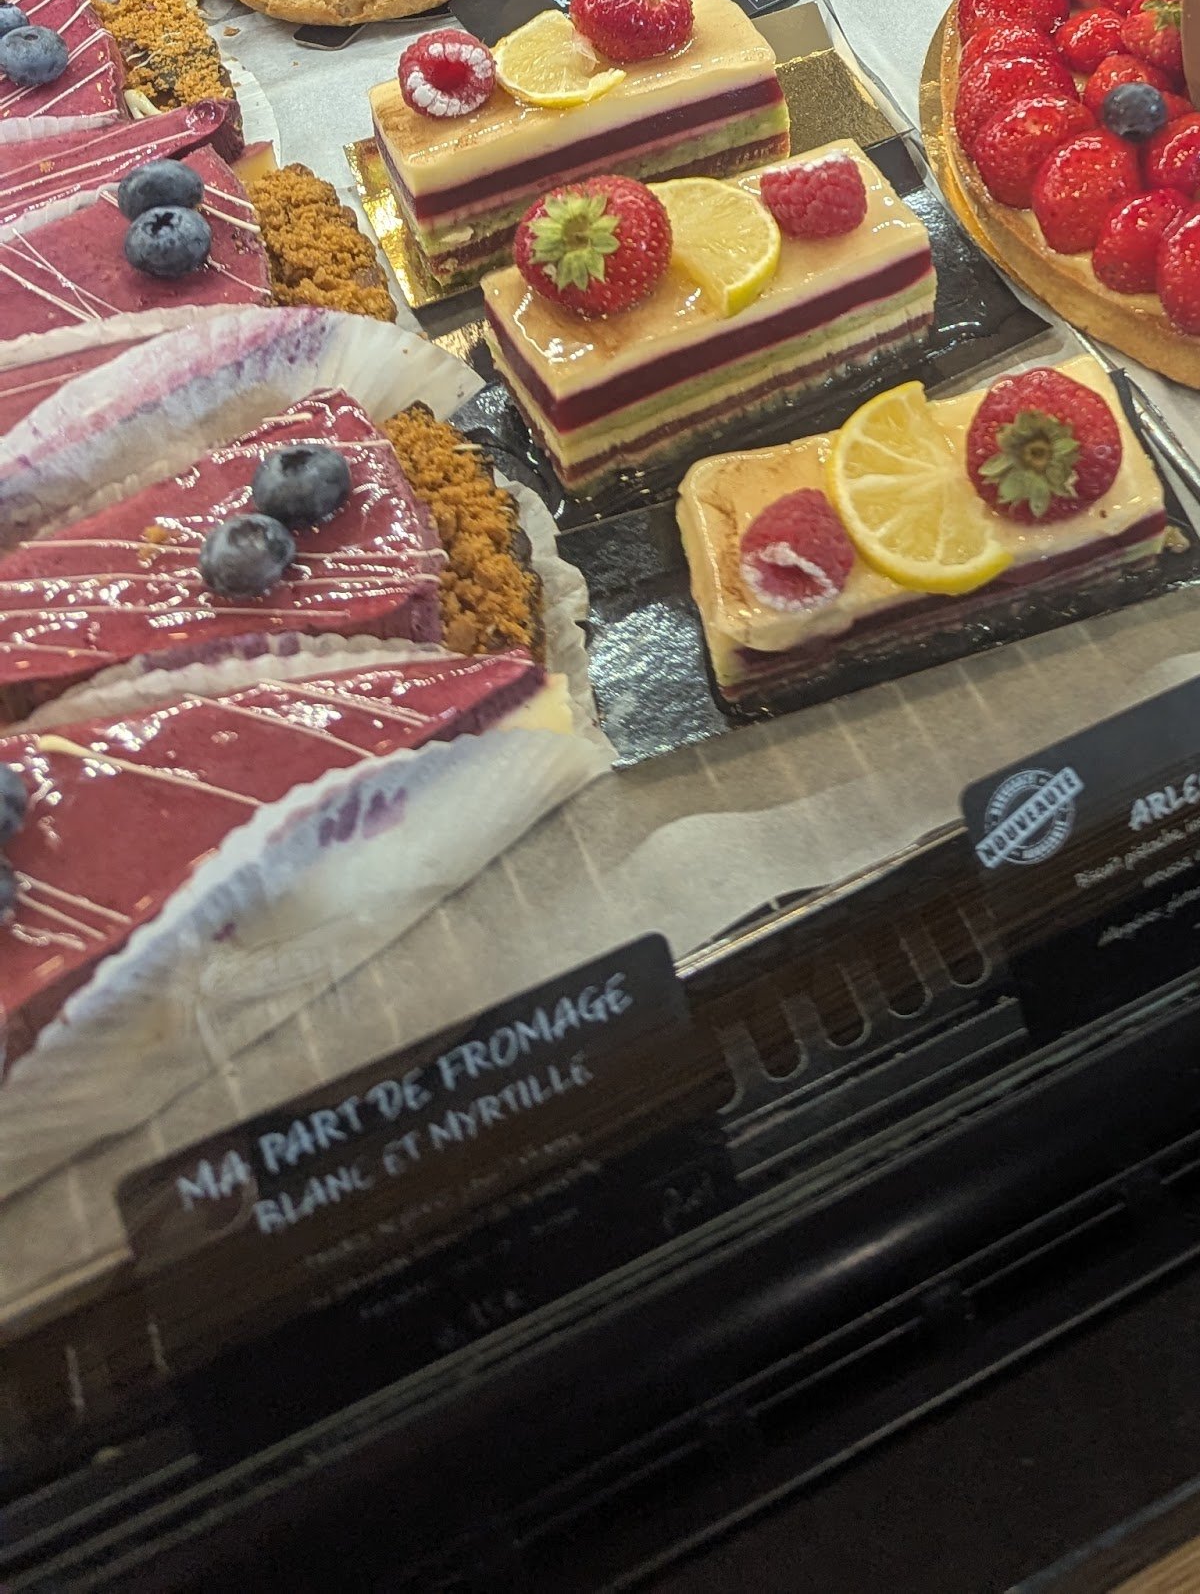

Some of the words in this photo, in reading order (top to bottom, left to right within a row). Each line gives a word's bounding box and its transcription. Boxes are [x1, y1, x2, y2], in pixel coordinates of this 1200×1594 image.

[177, 1149, 253, 1213] MA
[257, 1093, 366, 1173] PART
[365, 1066, 433, 1121] DE
[436, 971, 634, 1091] FROMAGE
[253, 1163, 377, 1235] BLANC
[381, 1130, 422, 1177] ET
[427, 1048, 596, 1152] MYRTILLE
